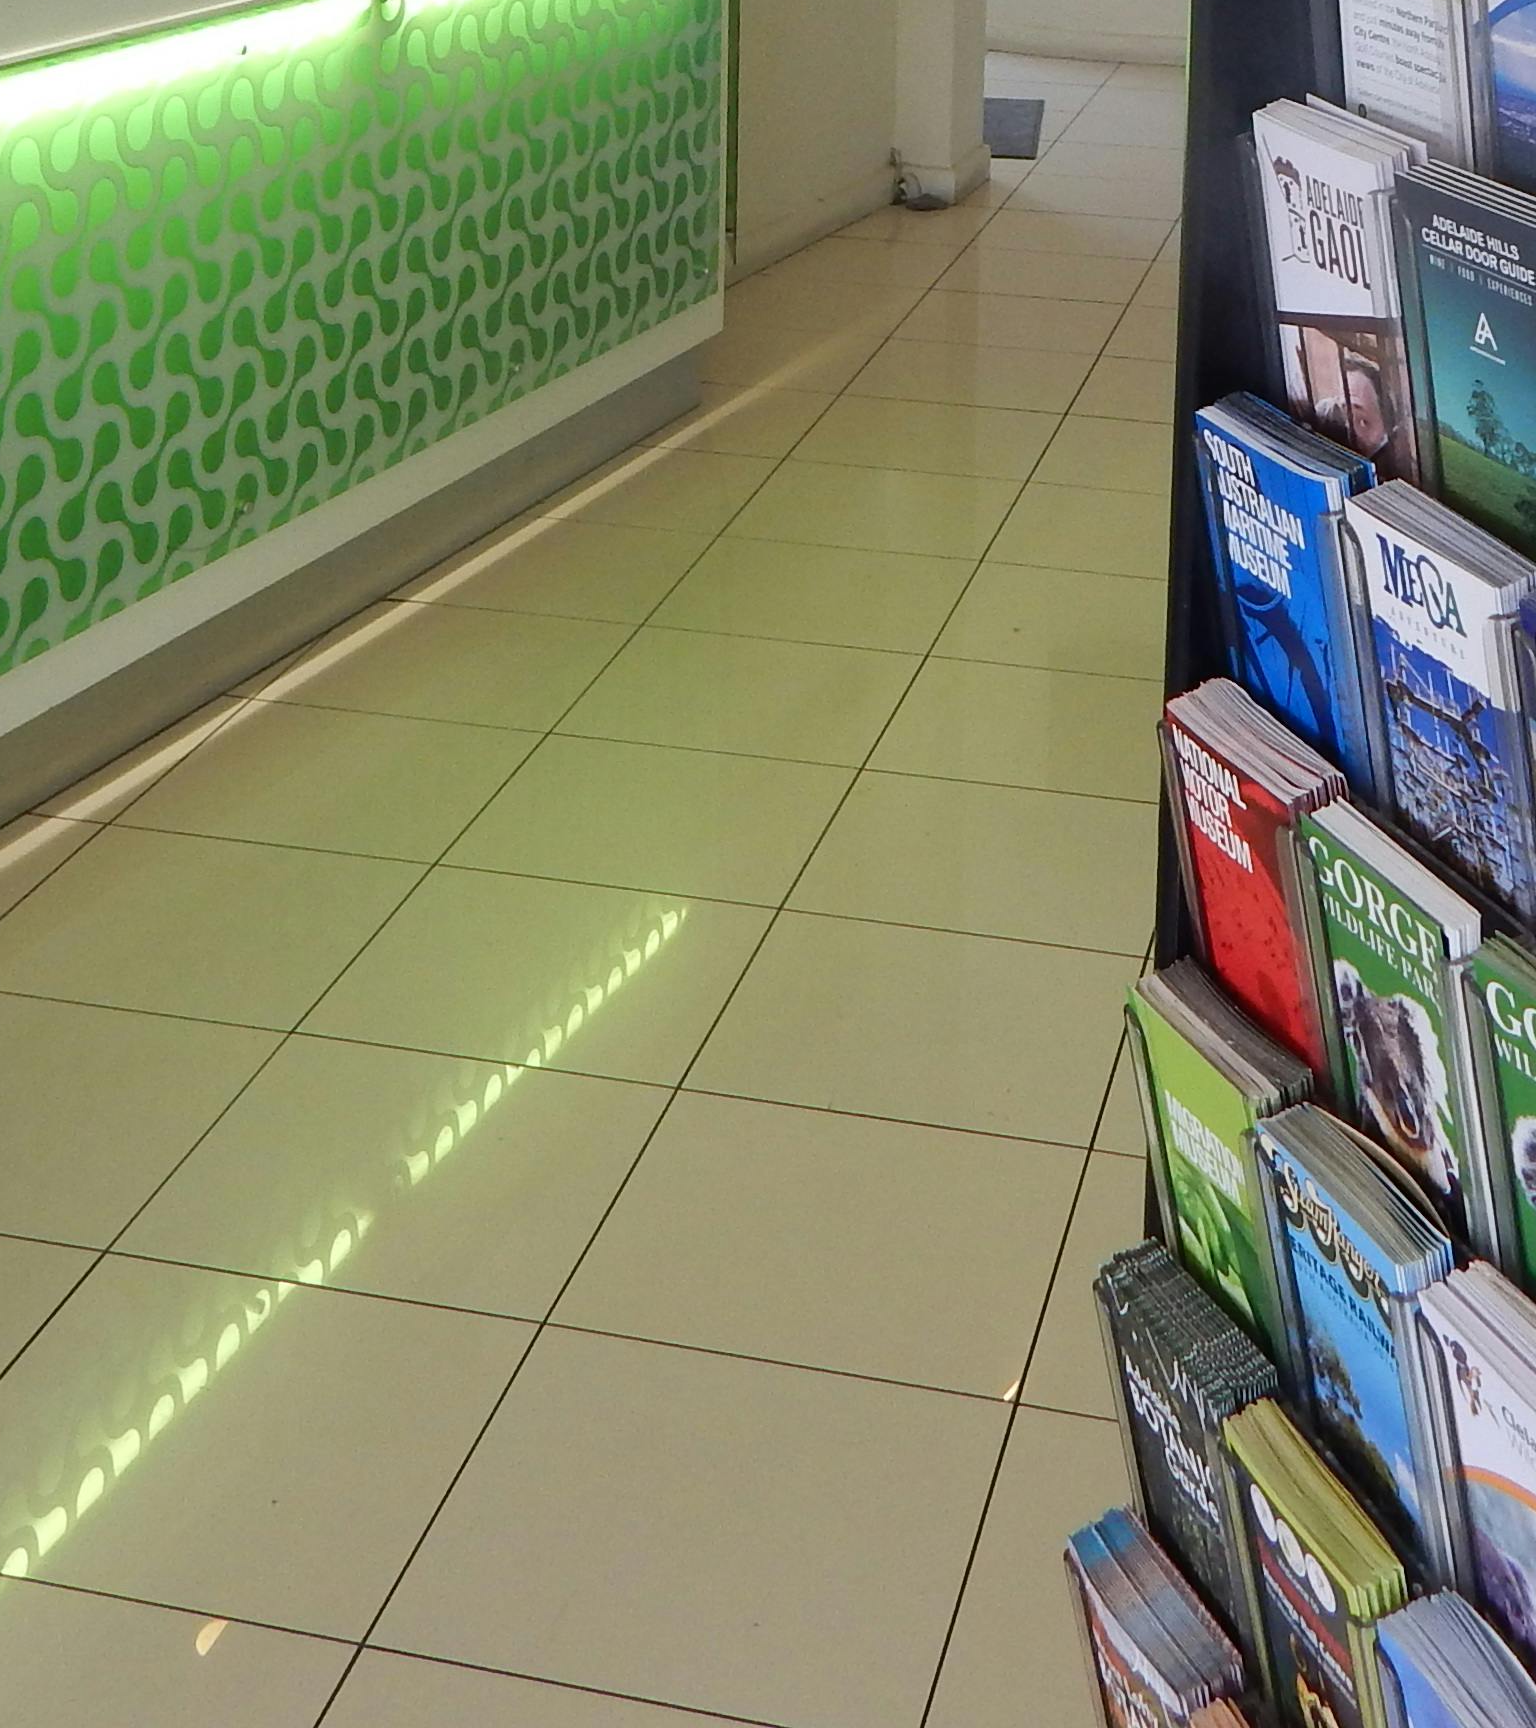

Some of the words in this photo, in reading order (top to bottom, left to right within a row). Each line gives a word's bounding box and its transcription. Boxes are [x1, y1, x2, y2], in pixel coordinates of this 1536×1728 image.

[1421, 226, 1464, 258] CELLAR
[1465, 241, 1499, 269] DOOR
[1499, 259, 1536, 287] GUIDE
[1432, 213, 1485, 249] ADELAIDE
[1485, 237, 1520, 260] HILLS
[1486, 276, 1534, 308] EXPERIENCES
[1202, 428, 1256, 487] SOUTH
[1171, 723, 1248, 811] NATIONAL
[1179, 757, 1233, 828] MOTOR
[1184, 790, 1254, 875] MUSEUM
[1164, 1089, 1245, 1188] MIGRATION
[1169, 1119, 1242, 1207] MUSEUM
